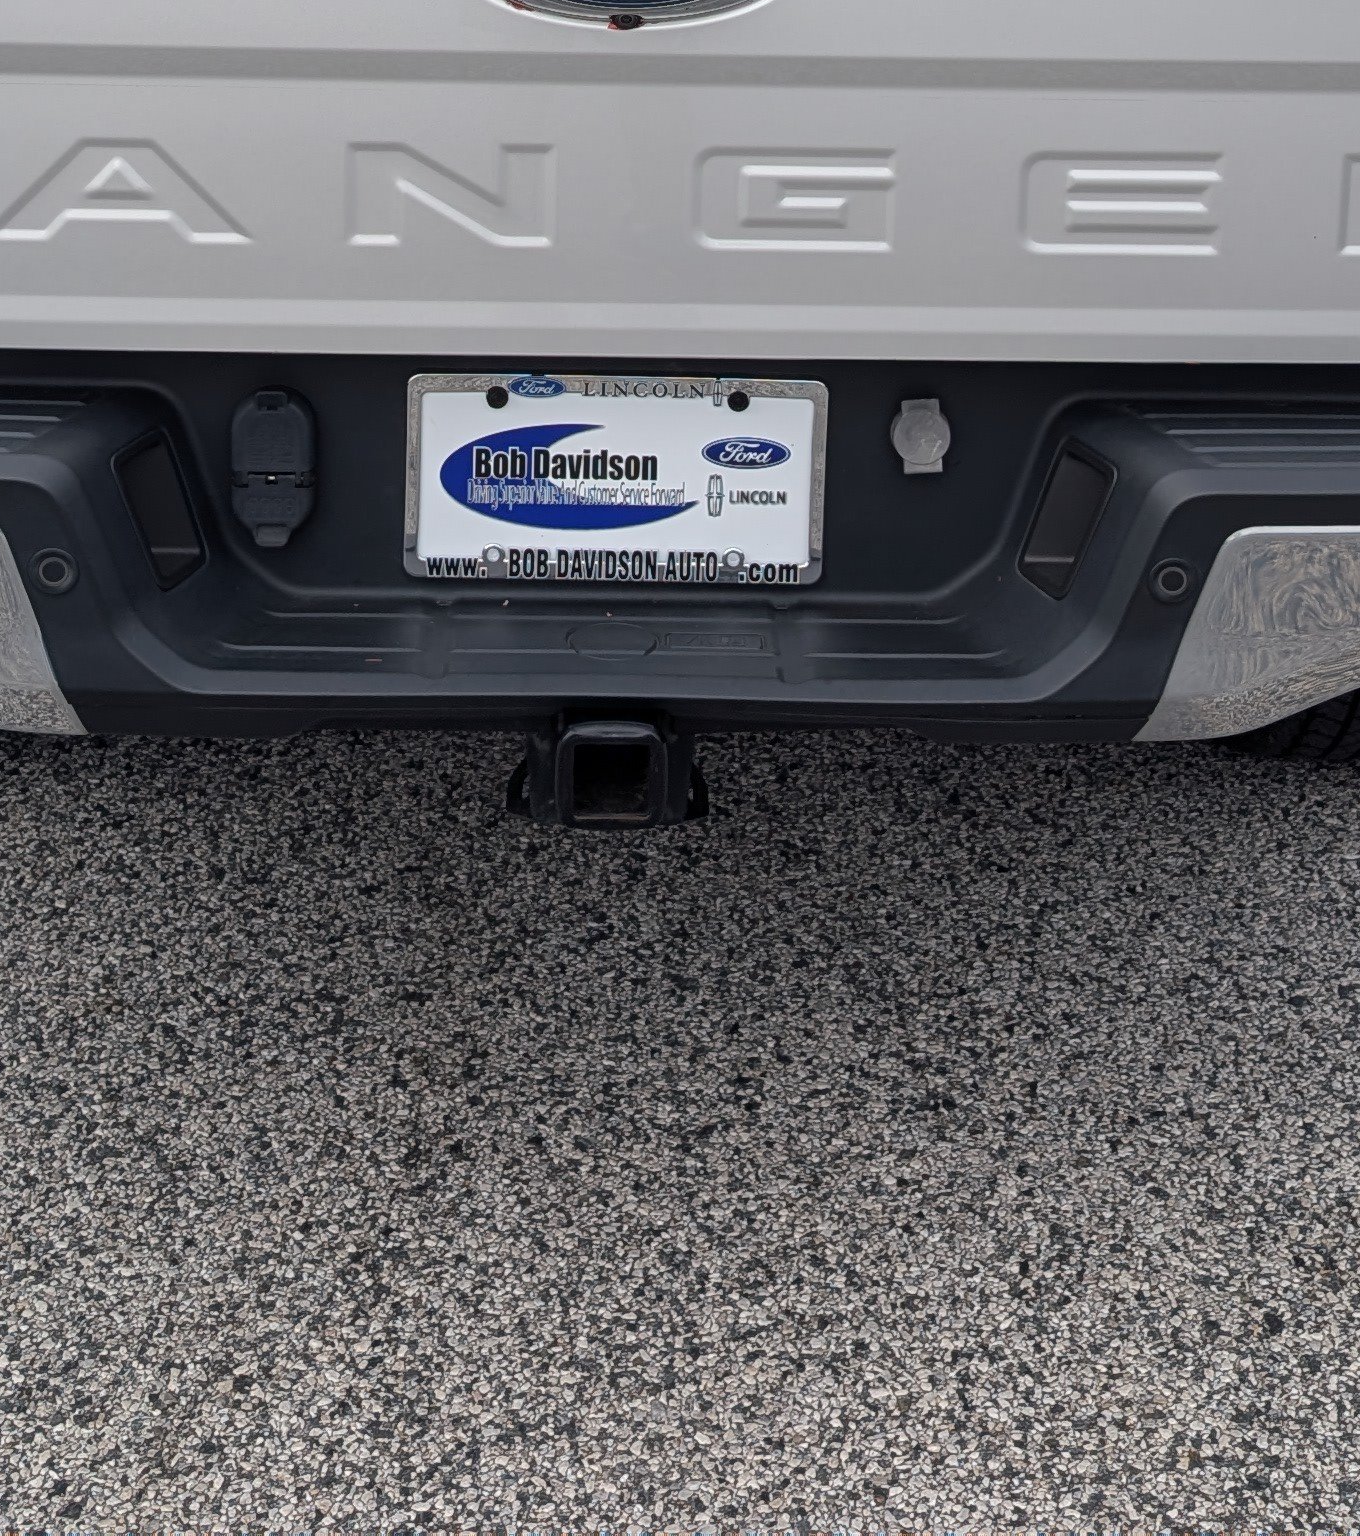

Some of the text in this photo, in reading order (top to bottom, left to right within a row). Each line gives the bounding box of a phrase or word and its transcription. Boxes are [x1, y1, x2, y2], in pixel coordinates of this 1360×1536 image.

[581, 381, 706, 400] LINCOLN
[473, 446, 658, 481] Bob Davidson
[719, 441, 773, 465] Ford
[578, 481, 619, 506] Customer
[619, 481, 650, 506] Service
[650, 482, 686, 506] Forward
[728, 489, 788, 505] LINCOLN
[507, 548, 549, 579] BOB
[555, 549, 658, 581] DAVIDSON
[664, 550, 719, 582] AUTO
